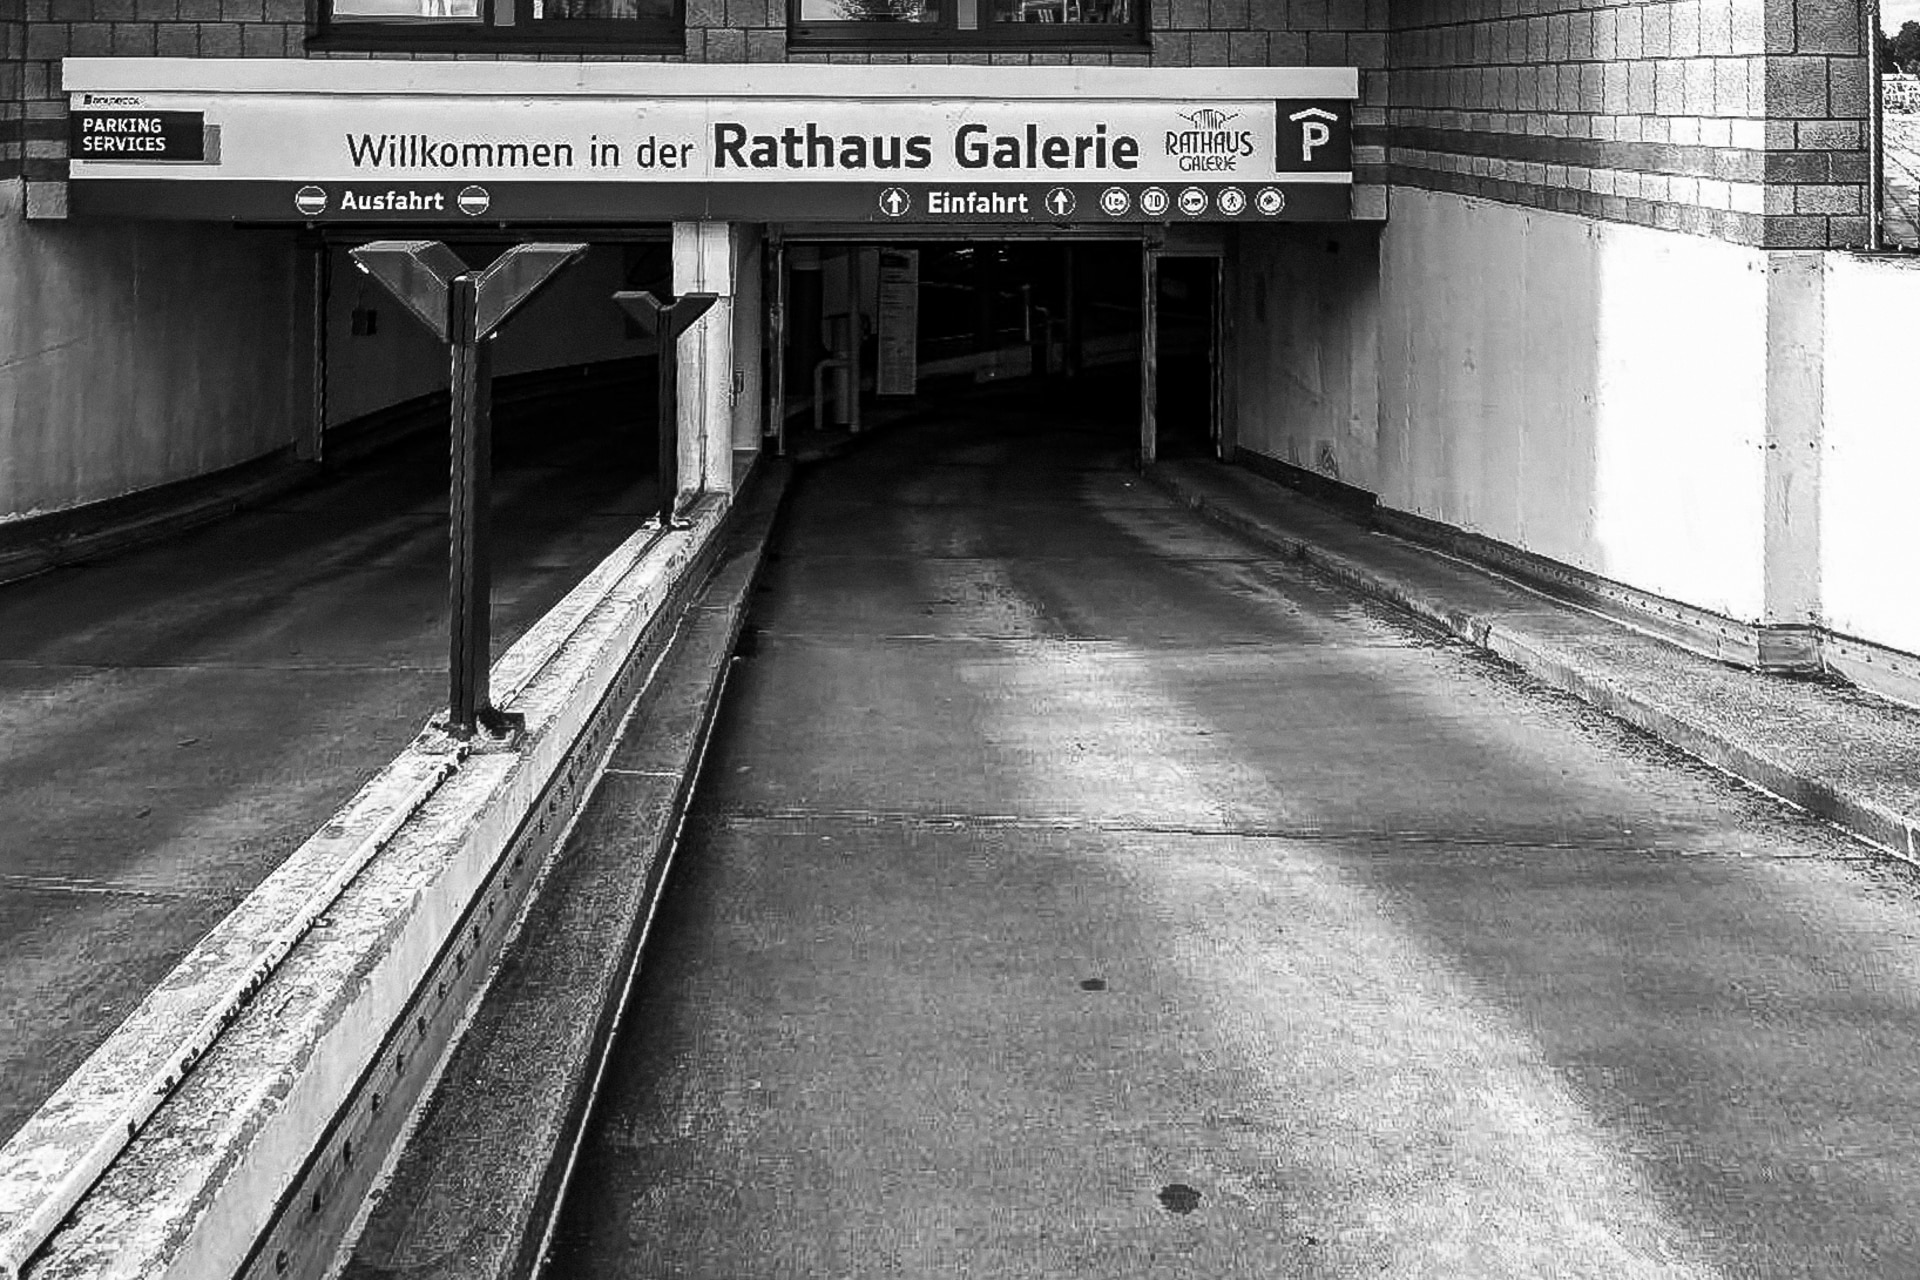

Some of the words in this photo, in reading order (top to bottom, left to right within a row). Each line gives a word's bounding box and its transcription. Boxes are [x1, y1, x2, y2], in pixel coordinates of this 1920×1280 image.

[83, 118, 162, 133] PARKING
[83, 136, 167, 151] SERVICES
[346, 133, 573, 168] Willkommen
[590, 134, 620, 168] in
[636, 135, 695, 168] der
[713, 122, 932, 169] Rathaus
[954, 123, 1140, 169] Galerie
[1165, 131, 1254, 157] RATHAUS
[1302, 121, 1330, 162] P
[1179, 155, 1237, 172] GALERIE
[340, 191, 445, 211] Ausfahrt
[928, 192, 1029, 214] Einfahrt
